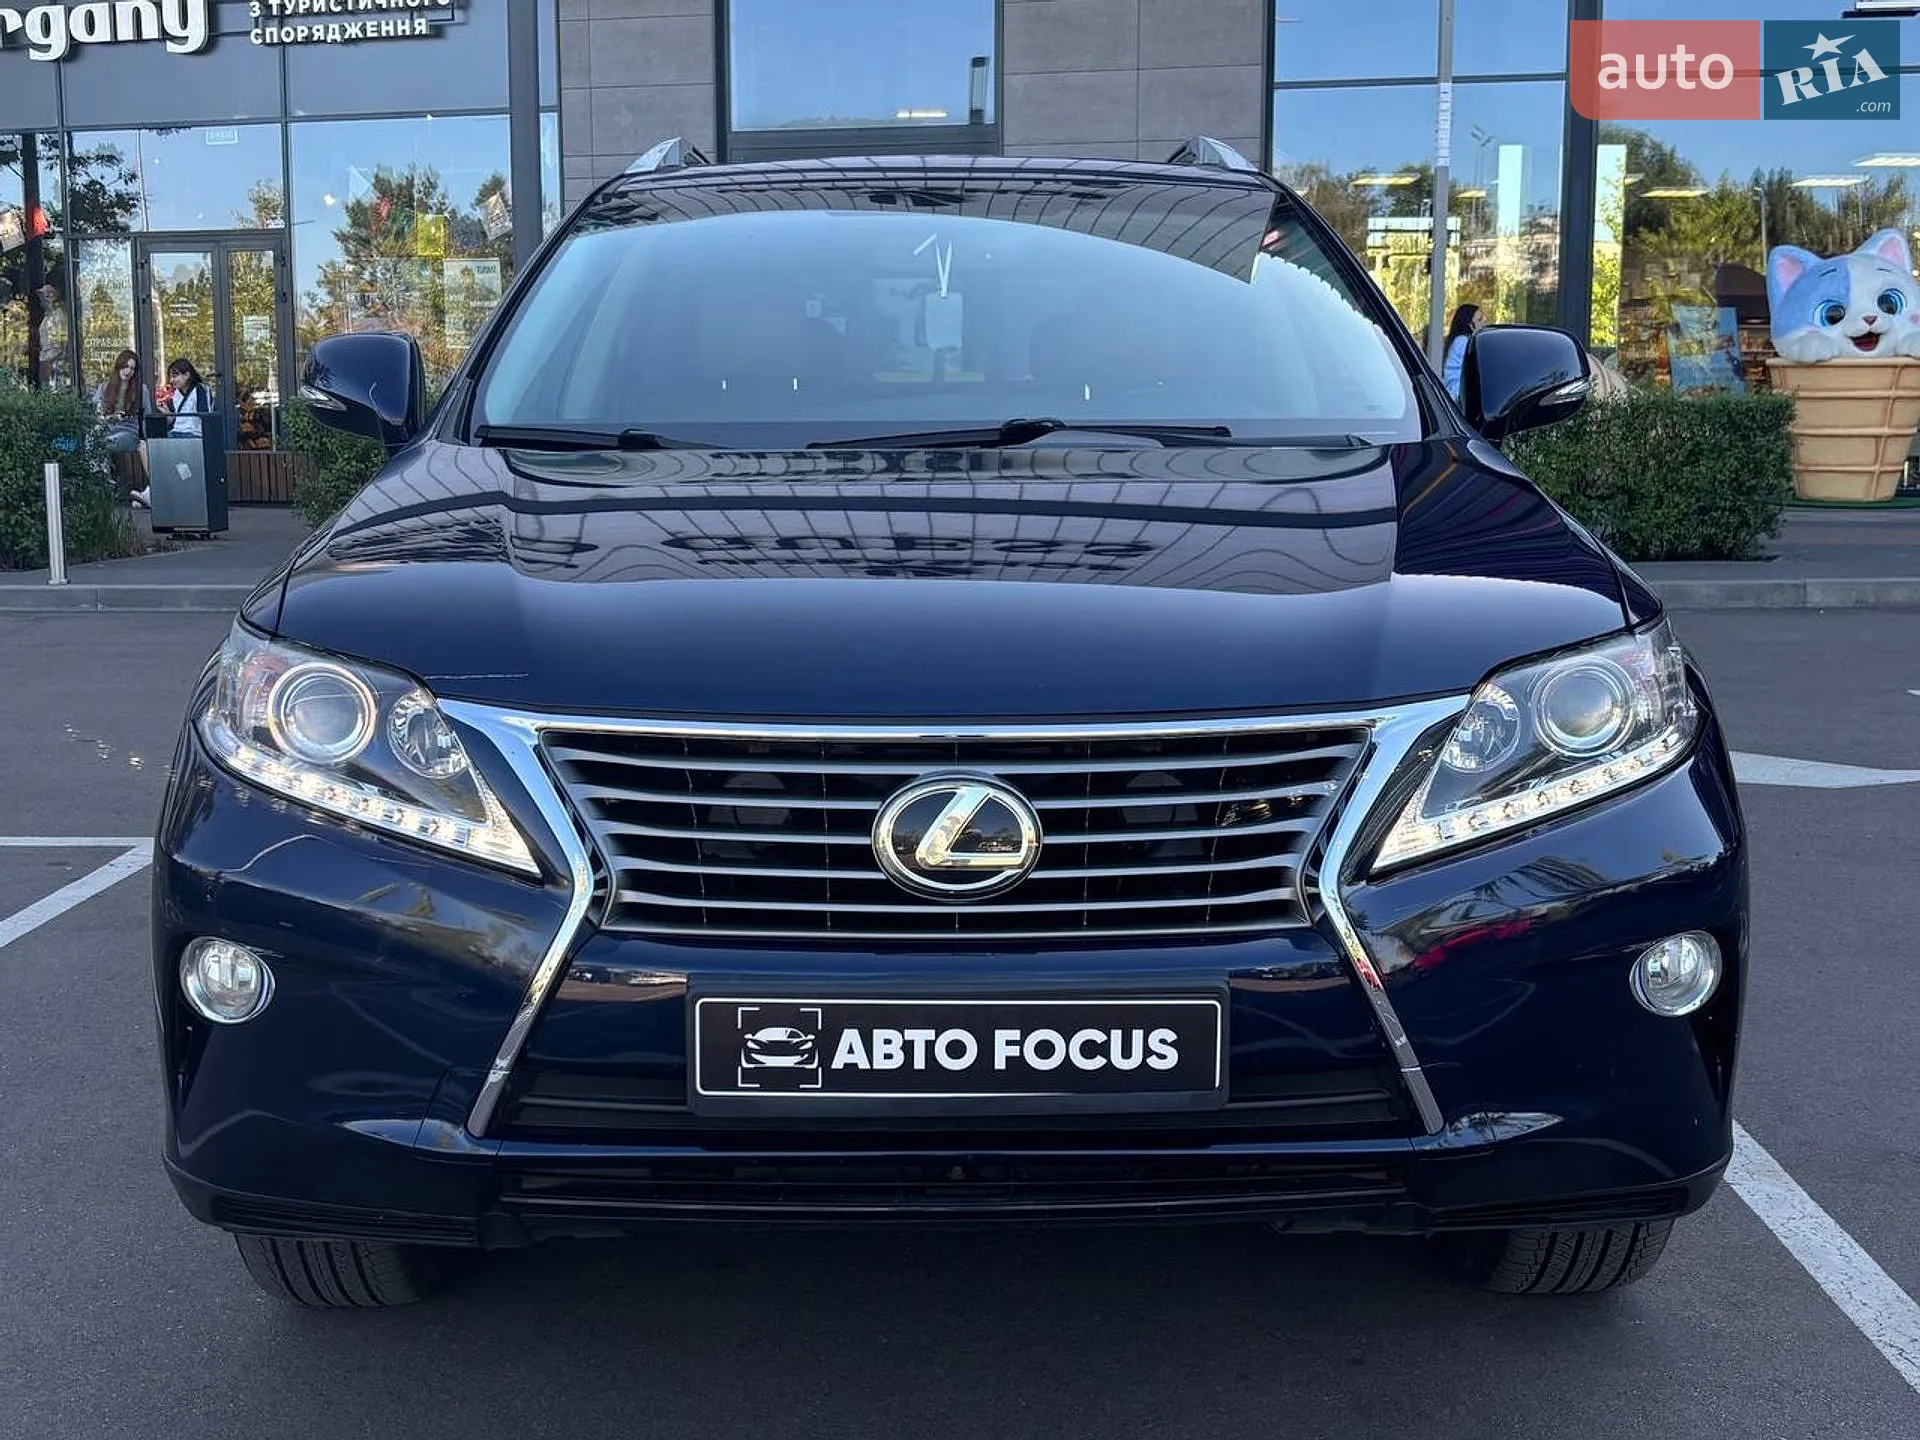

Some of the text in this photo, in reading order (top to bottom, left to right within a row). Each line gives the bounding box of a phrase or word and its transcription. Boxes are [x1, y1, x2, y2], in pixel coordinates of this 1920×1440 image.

[250, 18, 429, 45] СПОРЯДЖЕННЯ
[831, 1028, 1179, 1071] АВТО FOCUS
